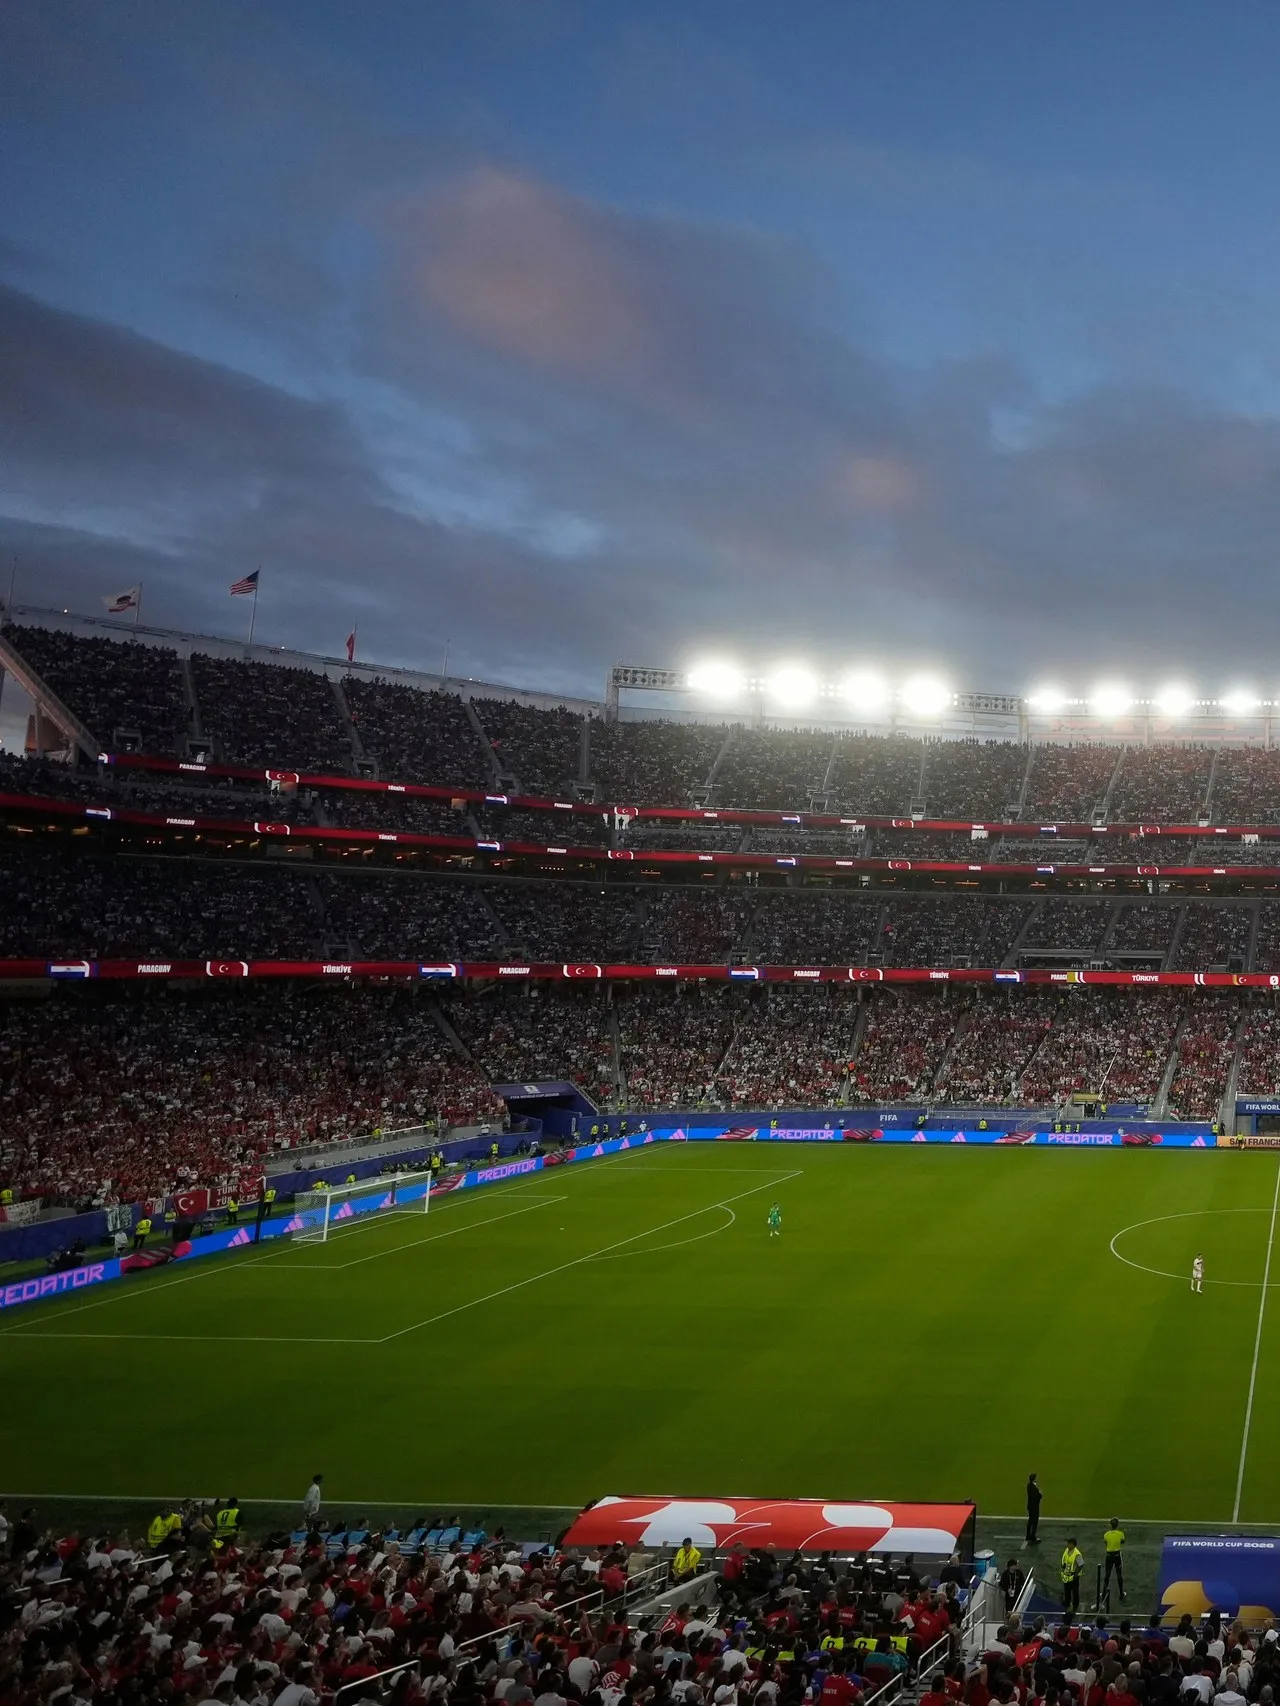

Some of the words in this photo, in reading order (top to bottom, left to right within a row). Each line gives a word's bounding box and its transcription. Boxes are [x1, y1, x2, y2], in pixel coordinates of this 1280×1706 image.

[166, 817, 196, 826] PARAGUAY
[137, 964, 172, 974] PARAGUAY
[498, 967, 531, 975] PARAGUAY
[793, 970, 821, 978] PARAGUAY
[1269, 975, 1279, 986] 0
[1245, 1103, 1261, 1111] FIFA
[879, 1114, 898, 1122] FIFA
[772, 1128, 833, 1139] PREDATOR
[1050, 1133, 1112, 1144] PREDATOR
[478, 1159, 535, 1181] PREDATOR
